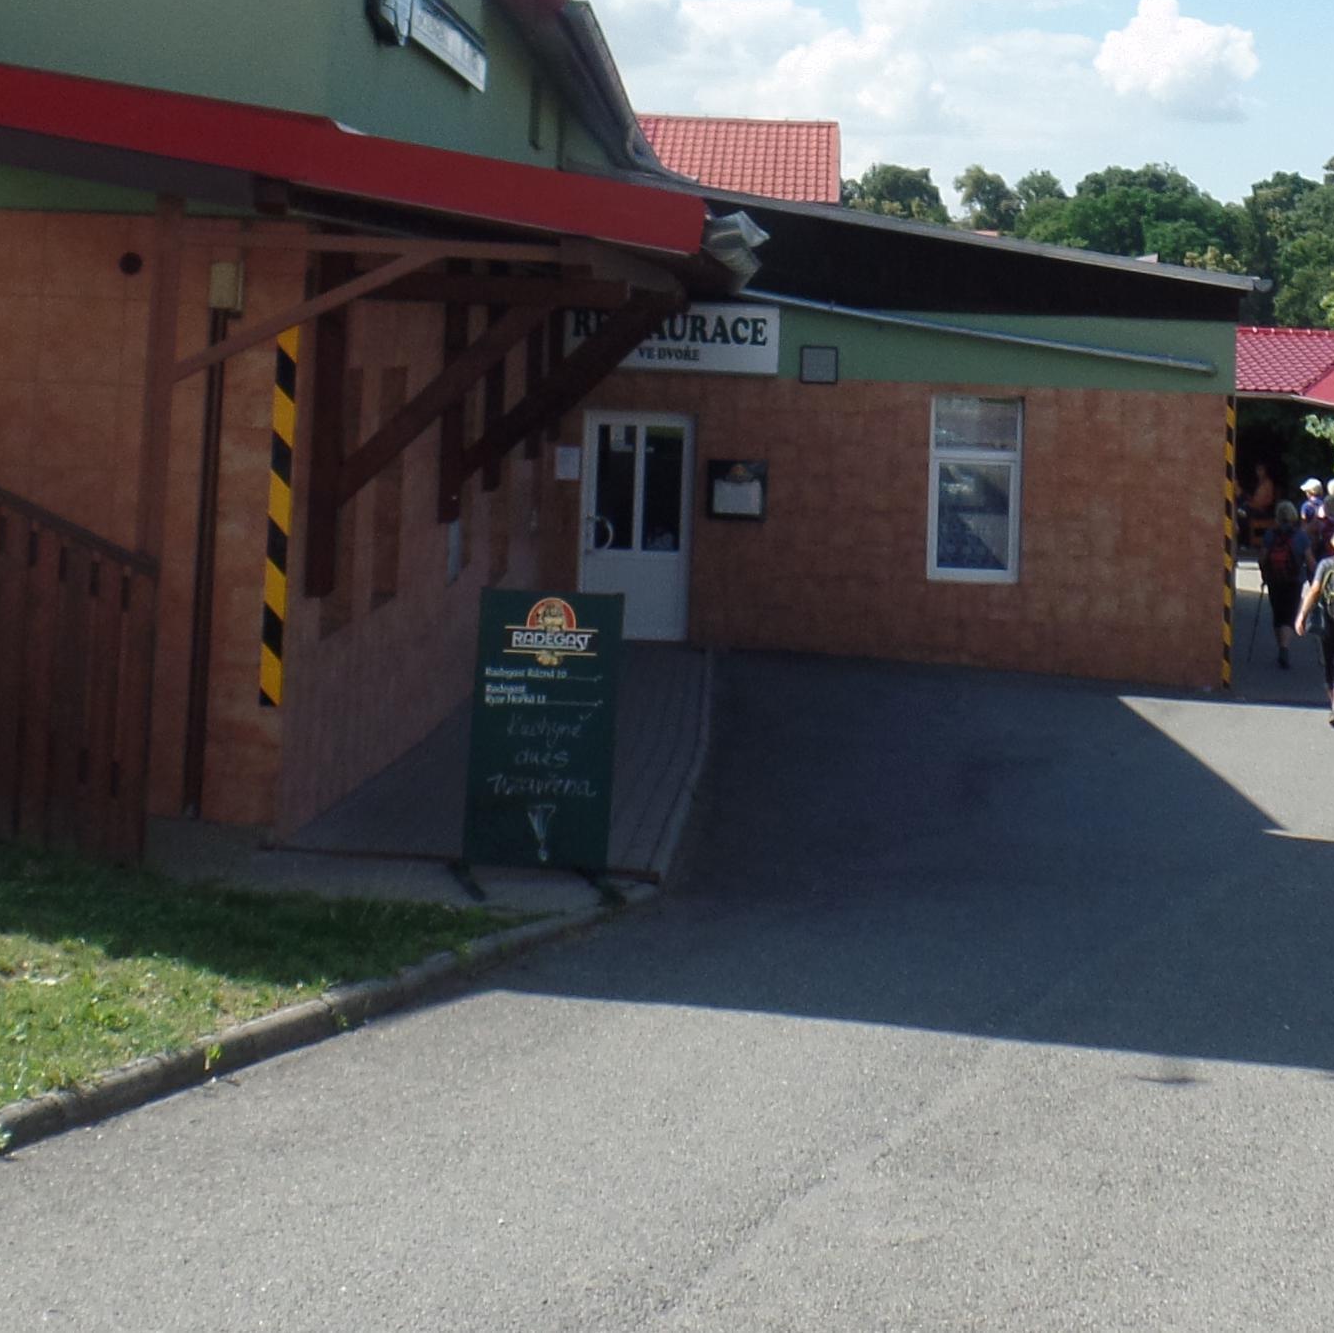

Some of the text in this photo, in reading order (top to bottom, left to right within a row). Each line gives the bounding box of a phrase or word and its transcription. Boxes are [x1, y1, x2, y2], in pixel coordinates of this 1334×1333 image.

[572, 307, 767, 347] REAURACE
[638, 344, 700, 362] VE DVOŘE
[511, 631, 593, 652] RADEGAST
